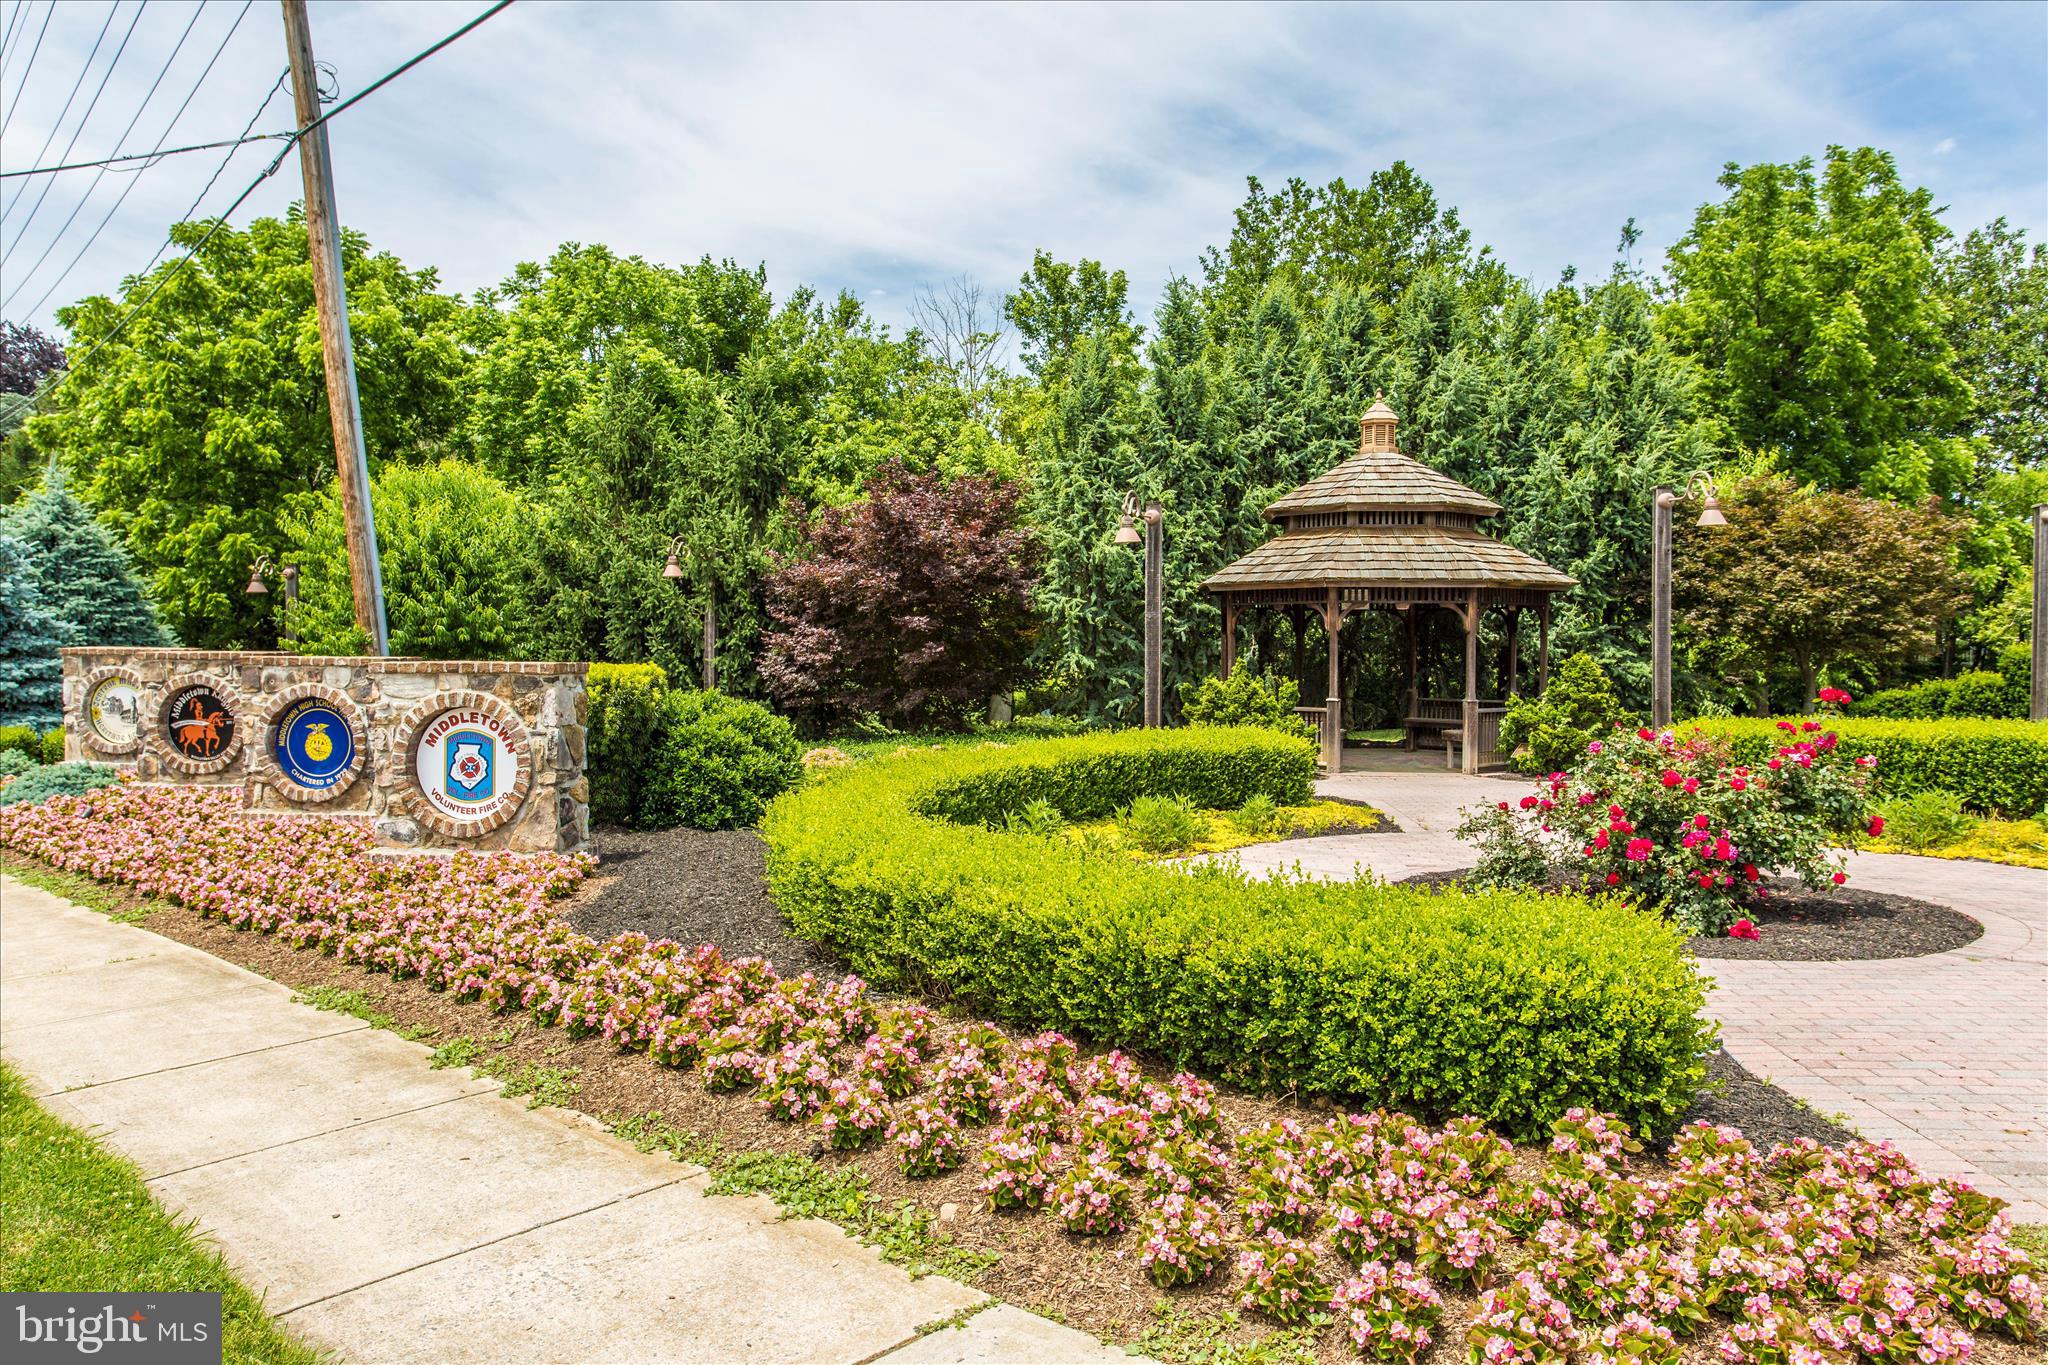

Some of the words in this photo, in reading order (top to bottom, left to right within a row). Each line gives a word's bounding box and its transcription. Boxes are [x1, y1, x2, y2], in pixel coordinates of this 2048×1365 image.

[278, 707, 300, 747] MIDDLETOWN
[298, 700, 315, 711] HIGH
[425, 711, 516, 755] MIDDLETOWN
[291, 768, 325, 786] CHARTERED
[326, 777, 335, 785] IN
[431, 787, 477, 815] VOLUNTEER
[479, 800, 498, 814] FIRE
